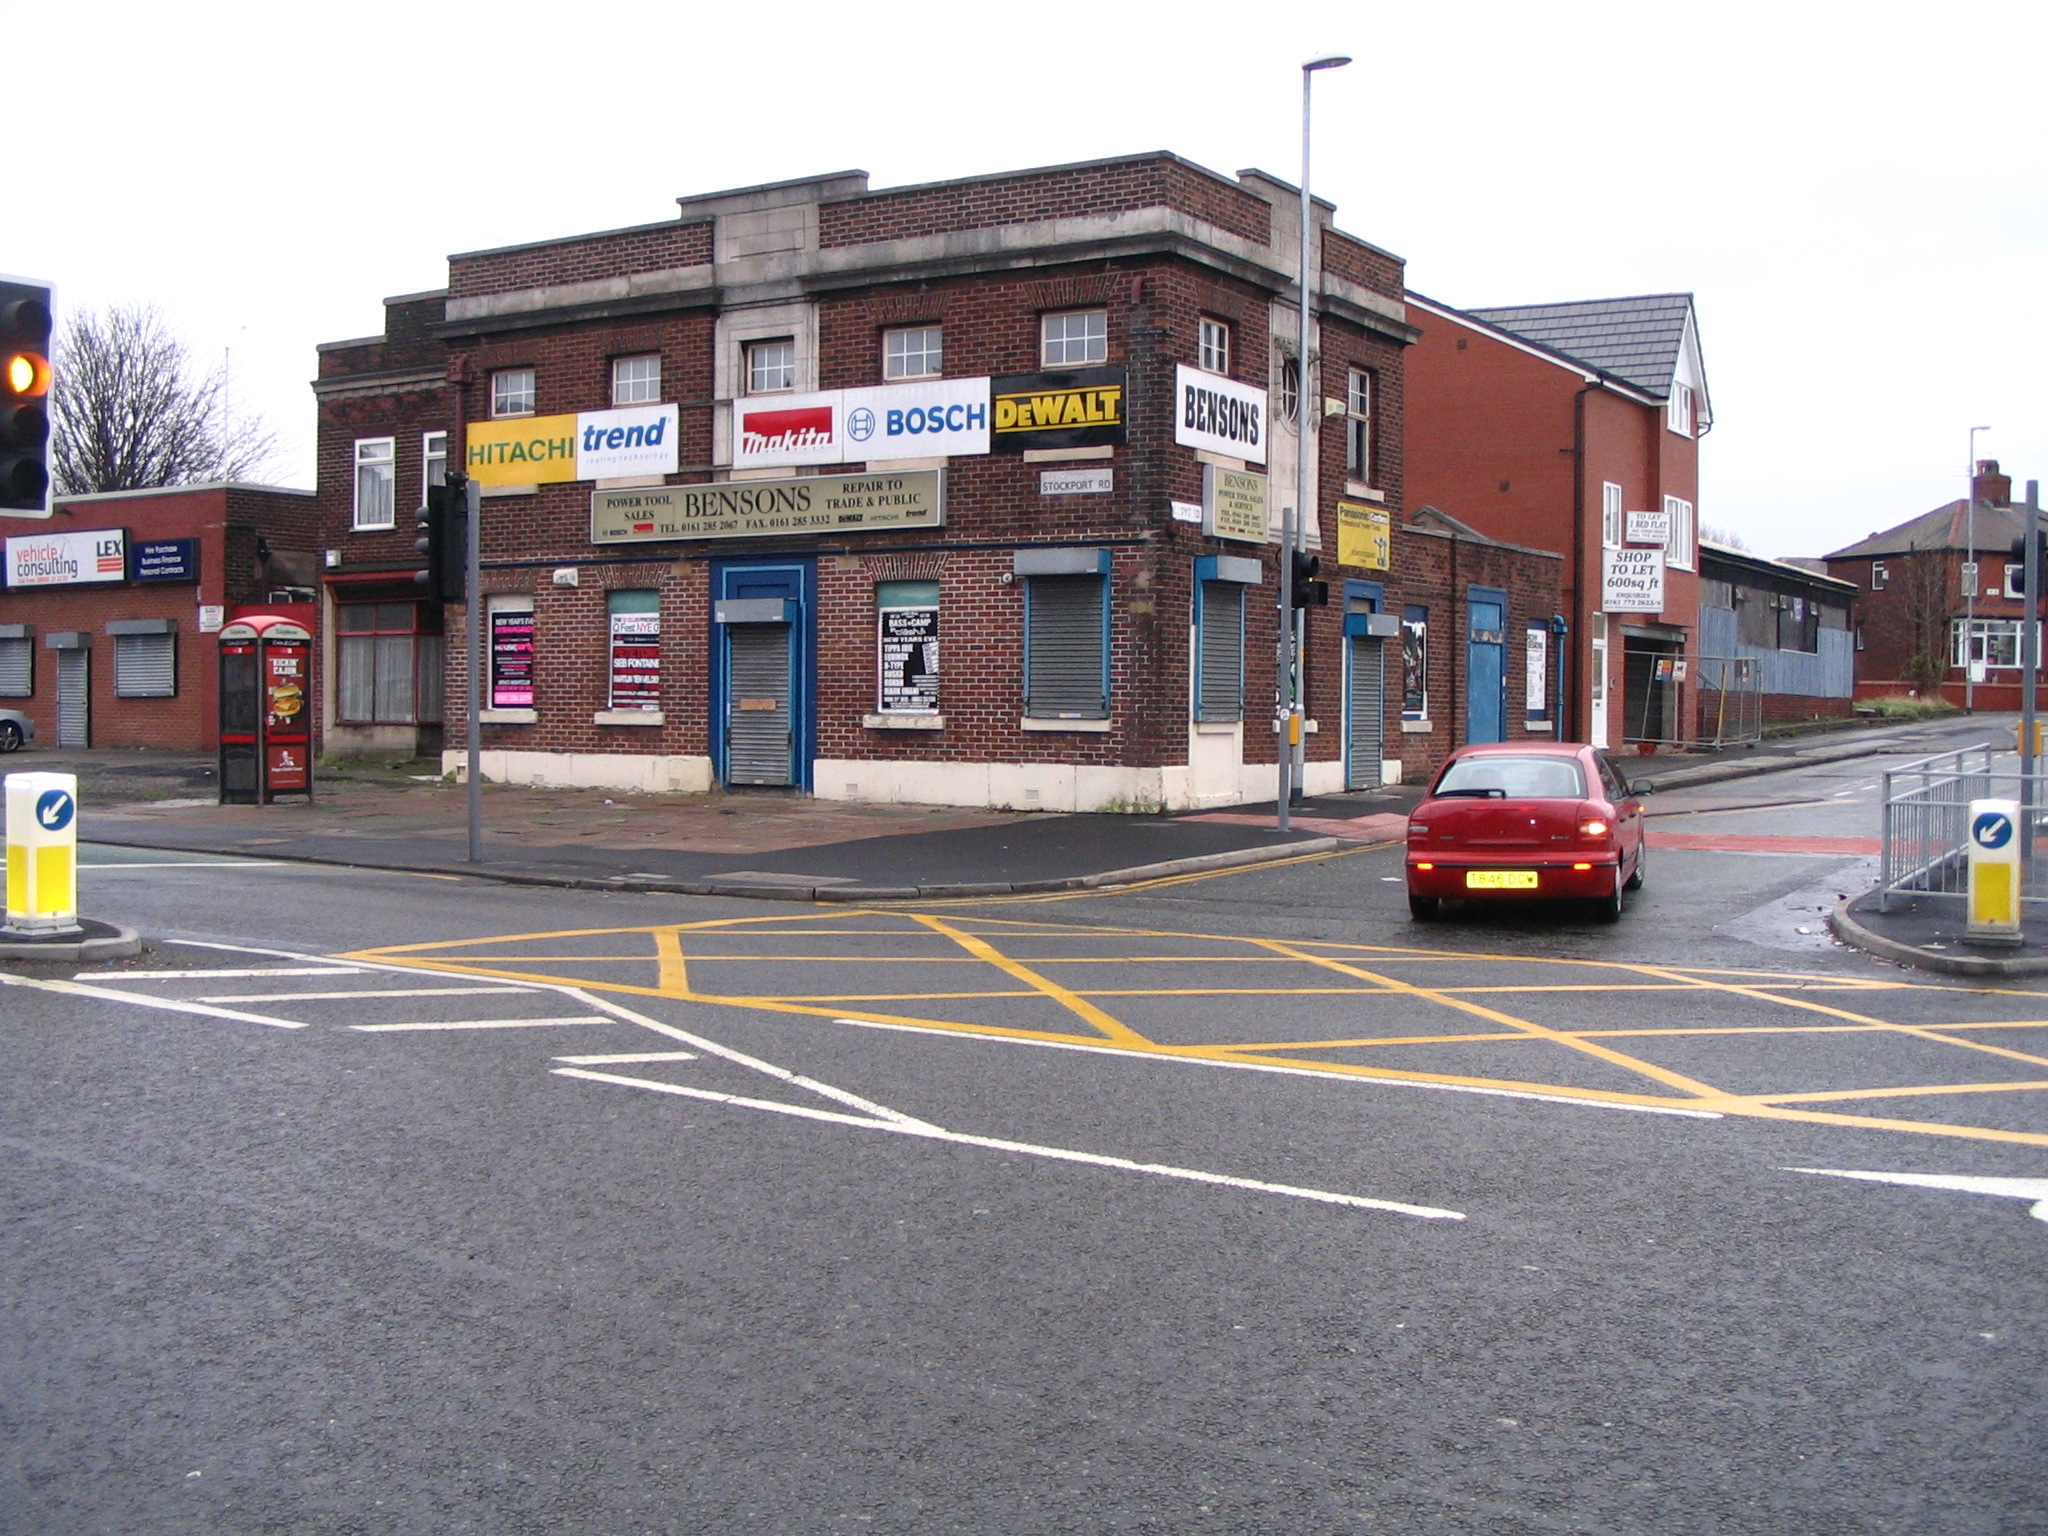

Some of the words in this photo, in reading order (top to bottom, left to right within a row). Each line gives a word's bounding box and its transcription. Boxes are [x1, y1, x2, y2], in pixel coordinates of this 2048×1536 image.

[886, 403, 986, 436] BOSCH
[1185, 385, 1259, 445] BENSONS
[583, 417, 667, 451] trend
[742, 427, 832, 454] makita
[469, 437, 574, 465] HITACHI
[842, 481, 884, 493] REPAIR
[887, 480, 903, 490] TO
[1043, 480, 1094, 491] STOCKPORT
[1098, 479, 1111, 489] RD
[607, 498, 642, 508] POWER
[644, 495, 672, 506] TOOL
[685, 486, 811, 518] BENSONS
[825, 496, 863, 509] TRADE
[866, 496, 874, 507] &
[878, 493, 921, 506] PUBLIC
[624, 510, 655, 521] SALES
[660, 524, 680, 533] TEL.
[681, 522, 700, 532] 0161
[703, 521, 717, 531] 285
[719, 520, 738, 530] 2067
[745, 519, 768, 529] FAX.
[769, 517, 789, 527] 0161
[792, 516, 807, 526] 285
[1650, 521, 1667, 529] FLAT
[16, 543, 58, 562] vehicle
[96, 540, 122, 556] LEX
[1616, 552, 1652, 562] SHOP
[17, 558, 78, 578] consulting
[1611, 564, 1628, 575] TO
[1632, 565, 1656, 575] LET
[1607, 577, 1645, 591] 600sq
[1647, 577, 1660, 590] ft
